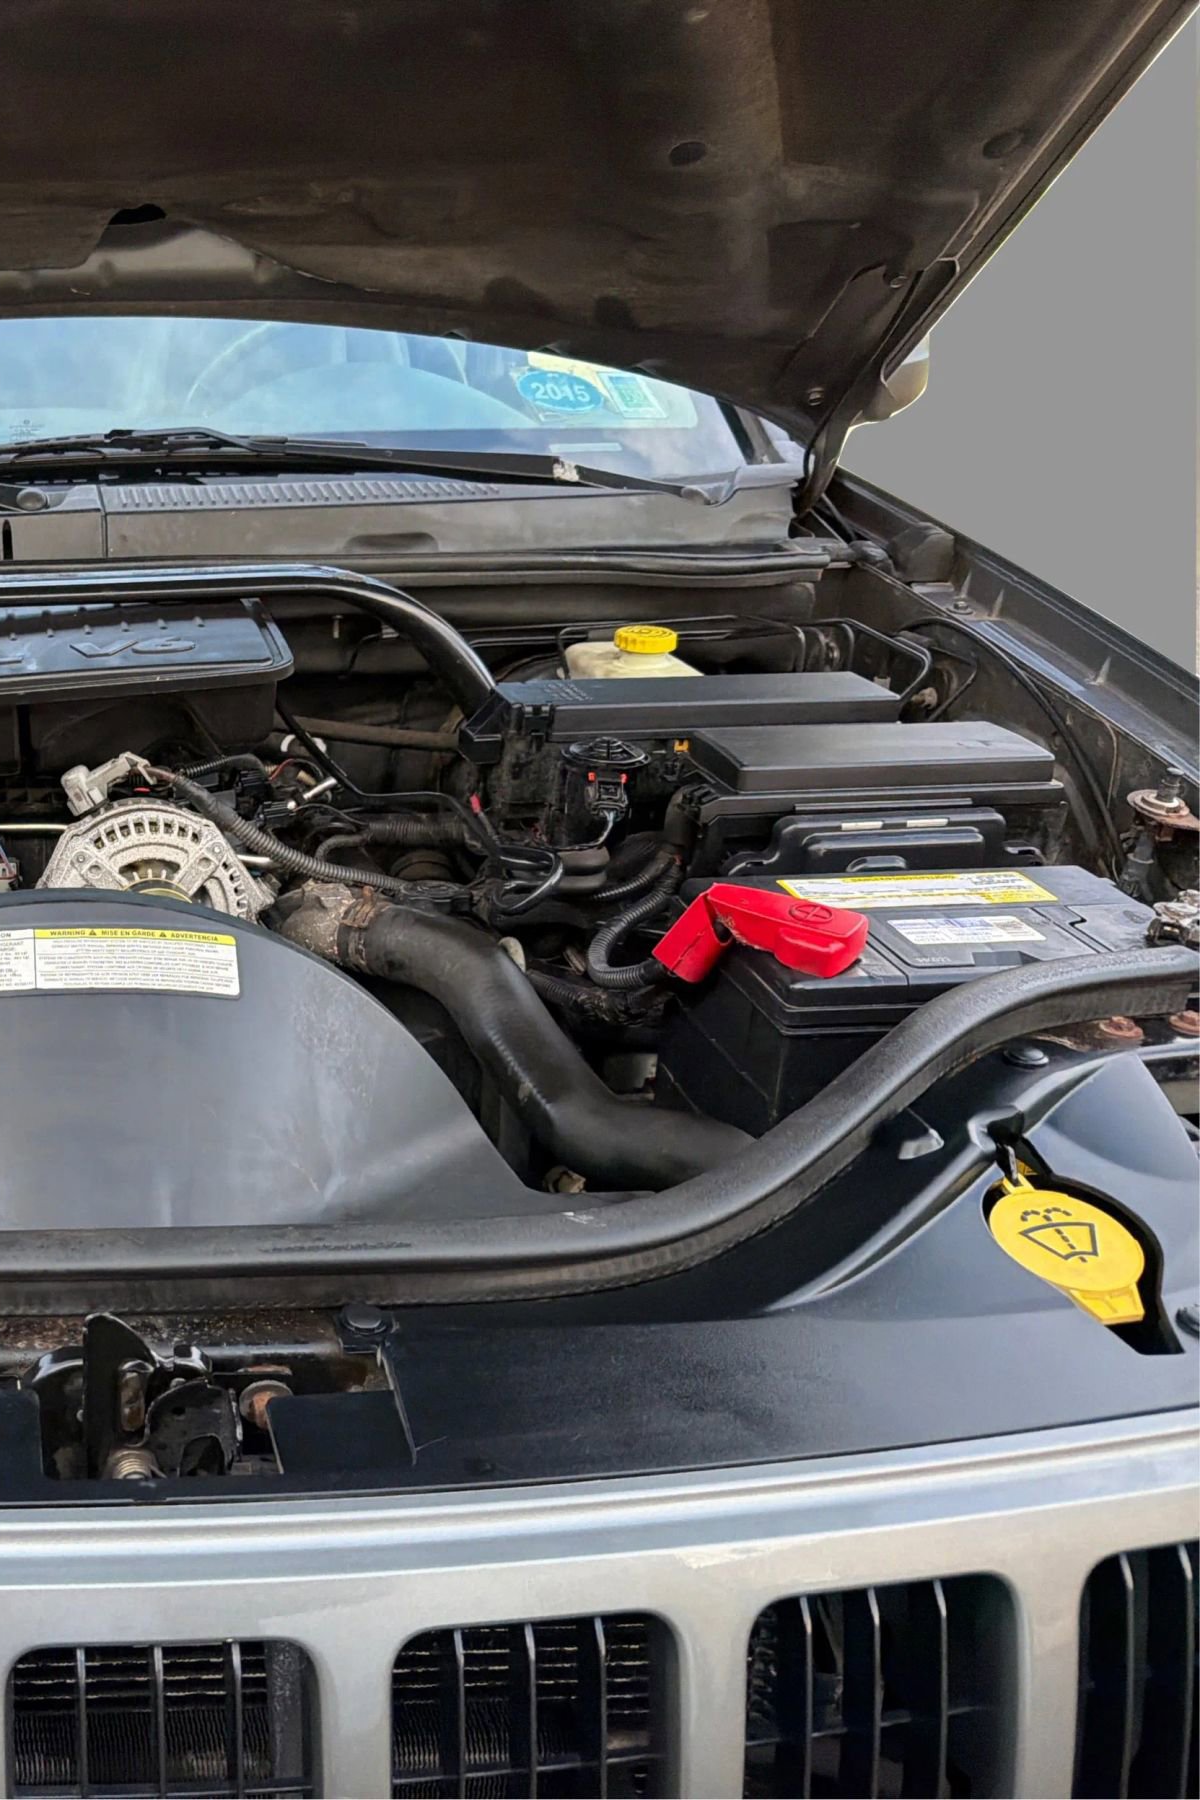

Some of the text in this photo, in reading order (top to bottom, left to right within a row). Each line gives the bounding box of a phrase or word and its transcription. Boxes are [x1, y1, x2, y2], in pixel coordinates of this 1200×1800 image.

[530, 381, 591, 403] 2015
[69, 636, 196, 658] V6
[131, 929, 156, 937] GARDE
[170, 931, 219, 942] ADVERTENCIA
